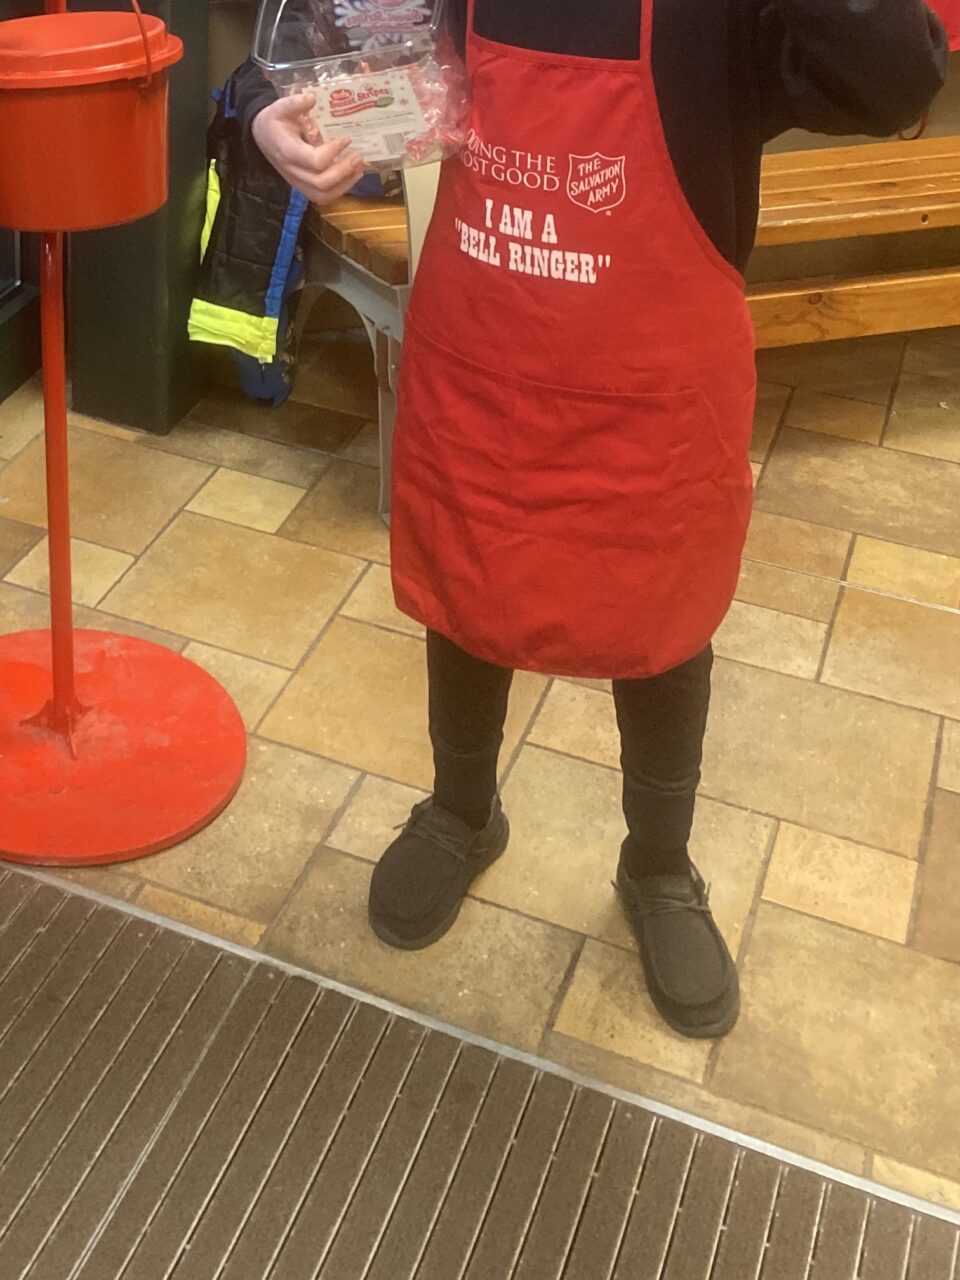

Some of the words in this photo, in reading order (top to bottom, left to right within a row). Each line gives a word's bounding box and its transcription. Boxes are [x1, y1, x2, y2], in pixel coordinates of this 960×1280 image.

[511, 150, 556, 173] THE
[577, 158, 602, 177] THE
[491, 164, 560, 191] GOOD
[570, 160, 621, 196] SALVATION
[587, 178, 619, 206] ARMY
[485, 198, 494, 228] I
[499, 204, 533, 240] AM
[541, 214, 558, 244] A
[455, 217, 501, 267] "BELL
[507, 241, 611, 285] RINGER"
